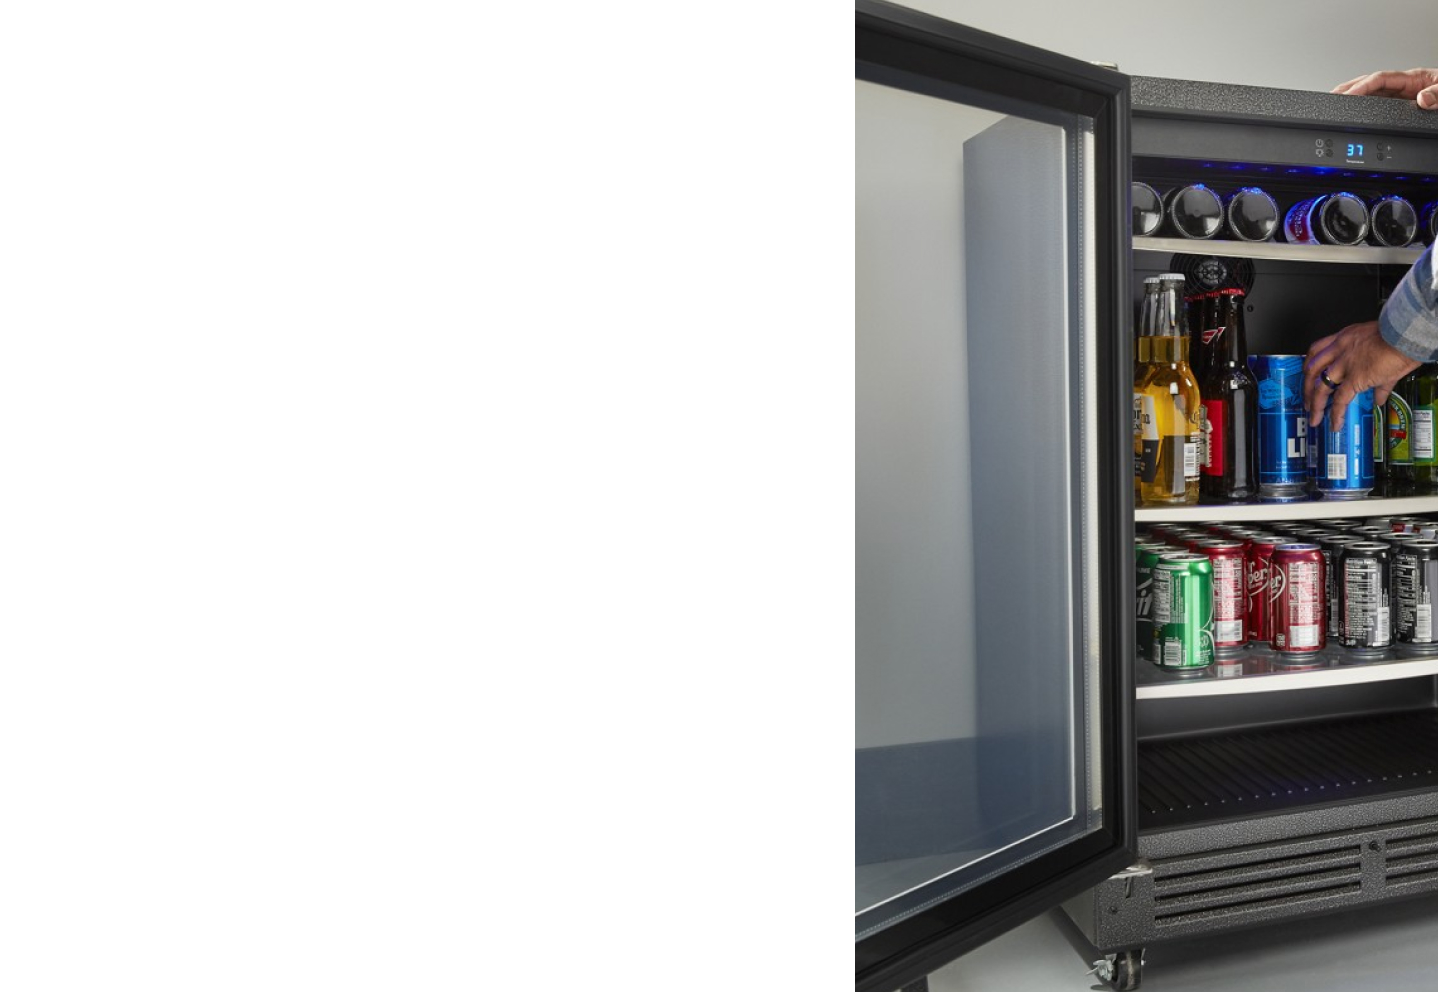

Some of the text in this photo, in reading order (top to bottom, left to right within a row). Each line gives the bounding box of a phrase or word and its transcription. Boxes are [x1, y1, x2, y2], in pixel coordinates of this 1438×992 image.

[1347, 143, 1363, 157] 37
[1297, 417, 1306, 437] B
[1287, 437, 1306, 458] LI
